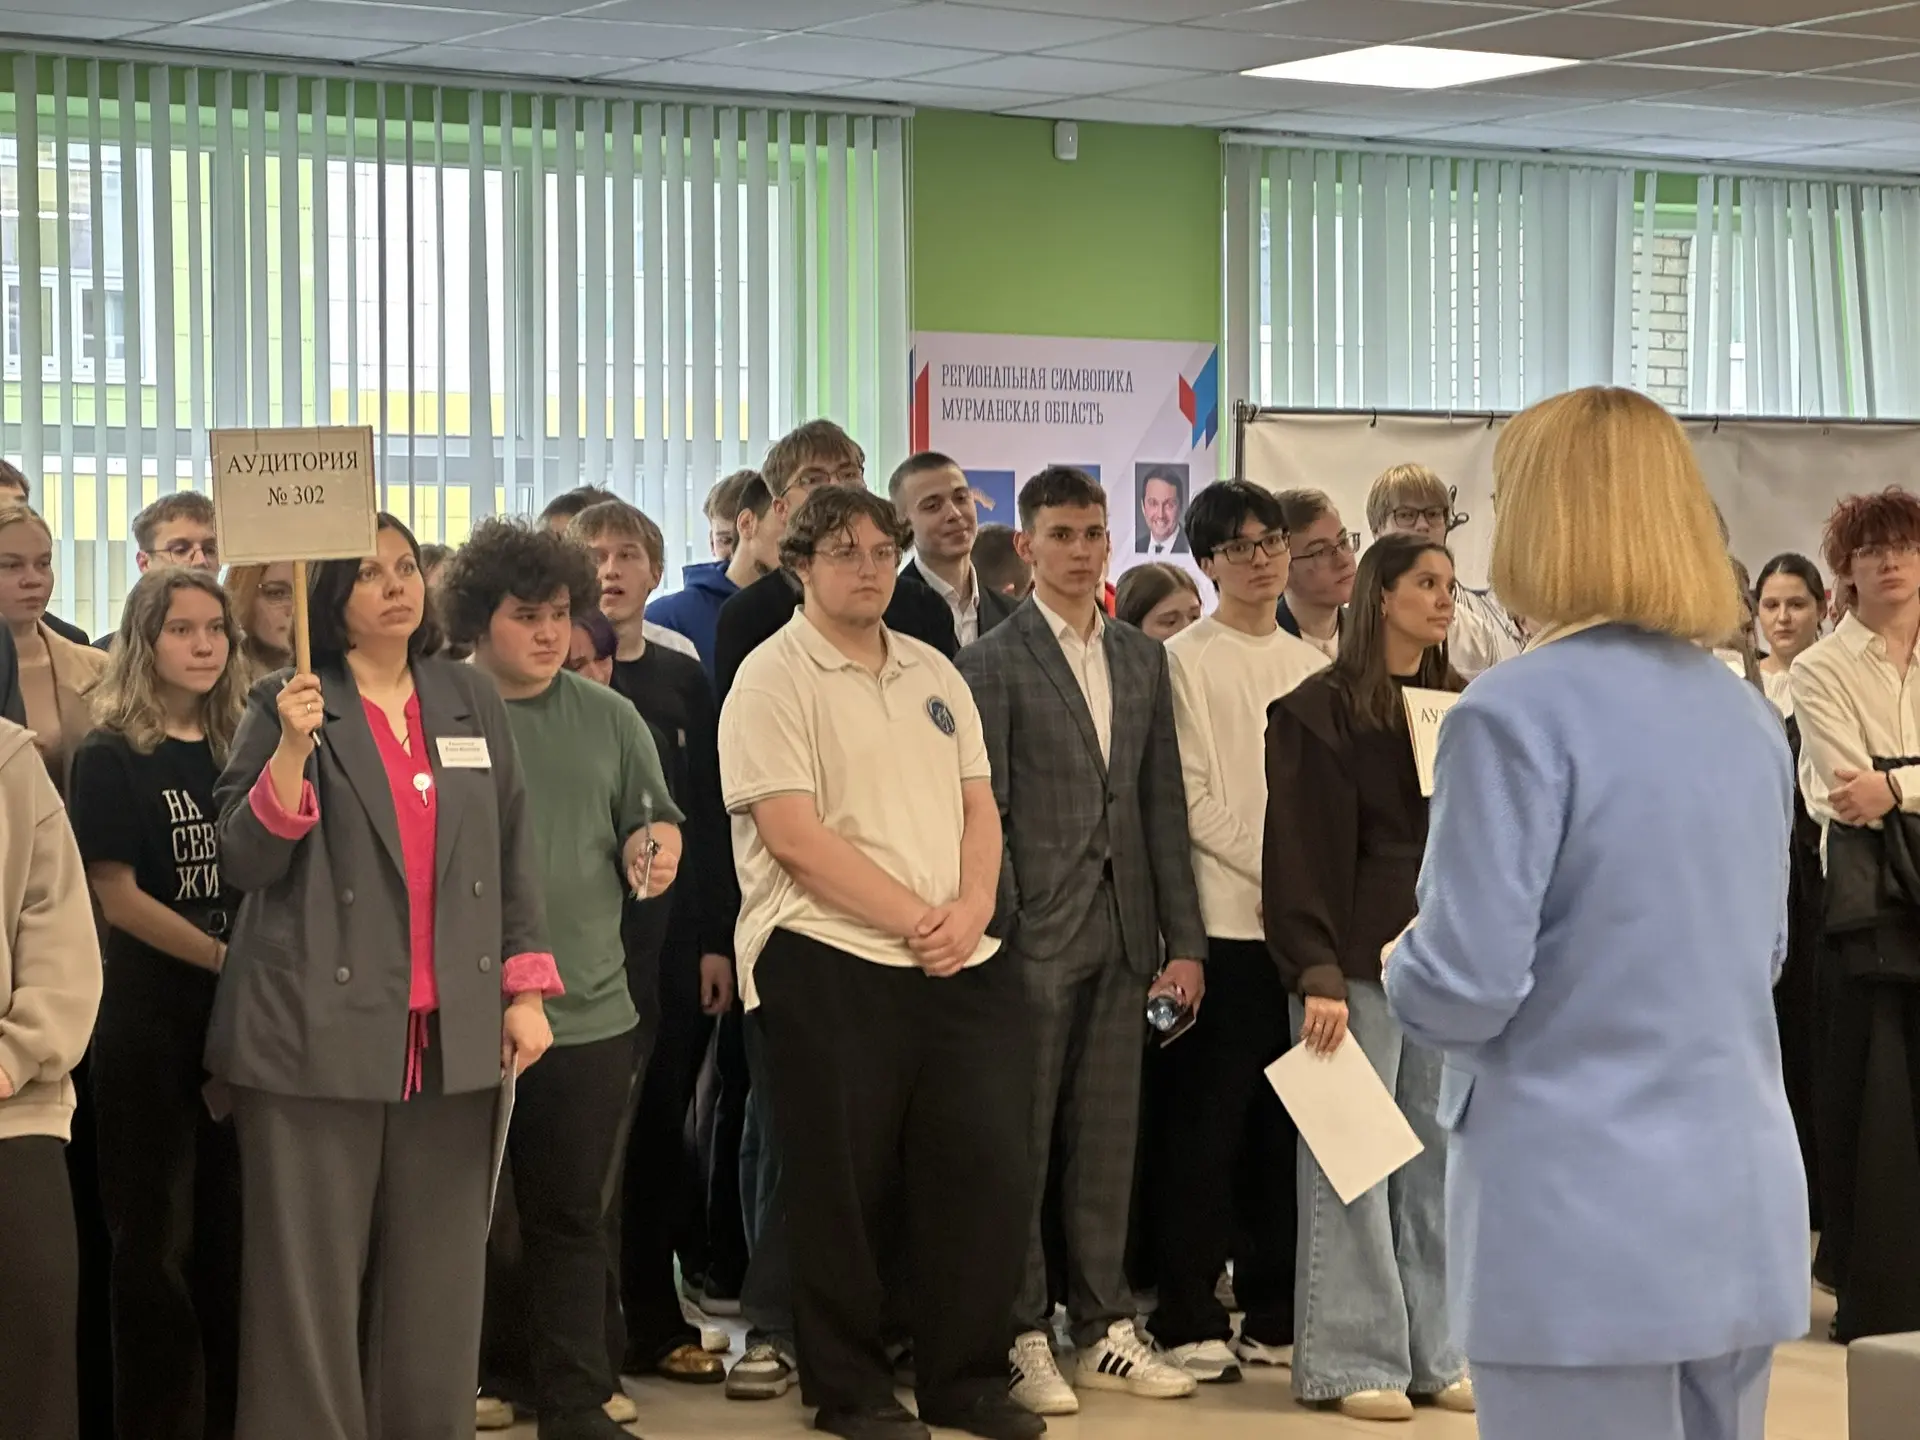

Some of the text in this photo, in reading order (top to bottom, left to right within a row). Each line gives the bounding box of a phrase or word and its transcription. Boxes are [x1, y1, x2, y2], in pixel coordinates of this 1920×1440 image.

[941, 364, 1134, 393] РЕГИОНАЛЬНАЯ СИМВОЛИКА
[941, 397, 1104, 425] МУРМАНСКАЯ ОБЛАСТЬ
[227, 450, 358, 476] АУДИТОРИЯ
[267, 485, 325, 506] № 302
[1421, 708, 1445, 724] АУ
[162, 789, 204, 823] НА
[172, 822, 218, 863] СЕВ
